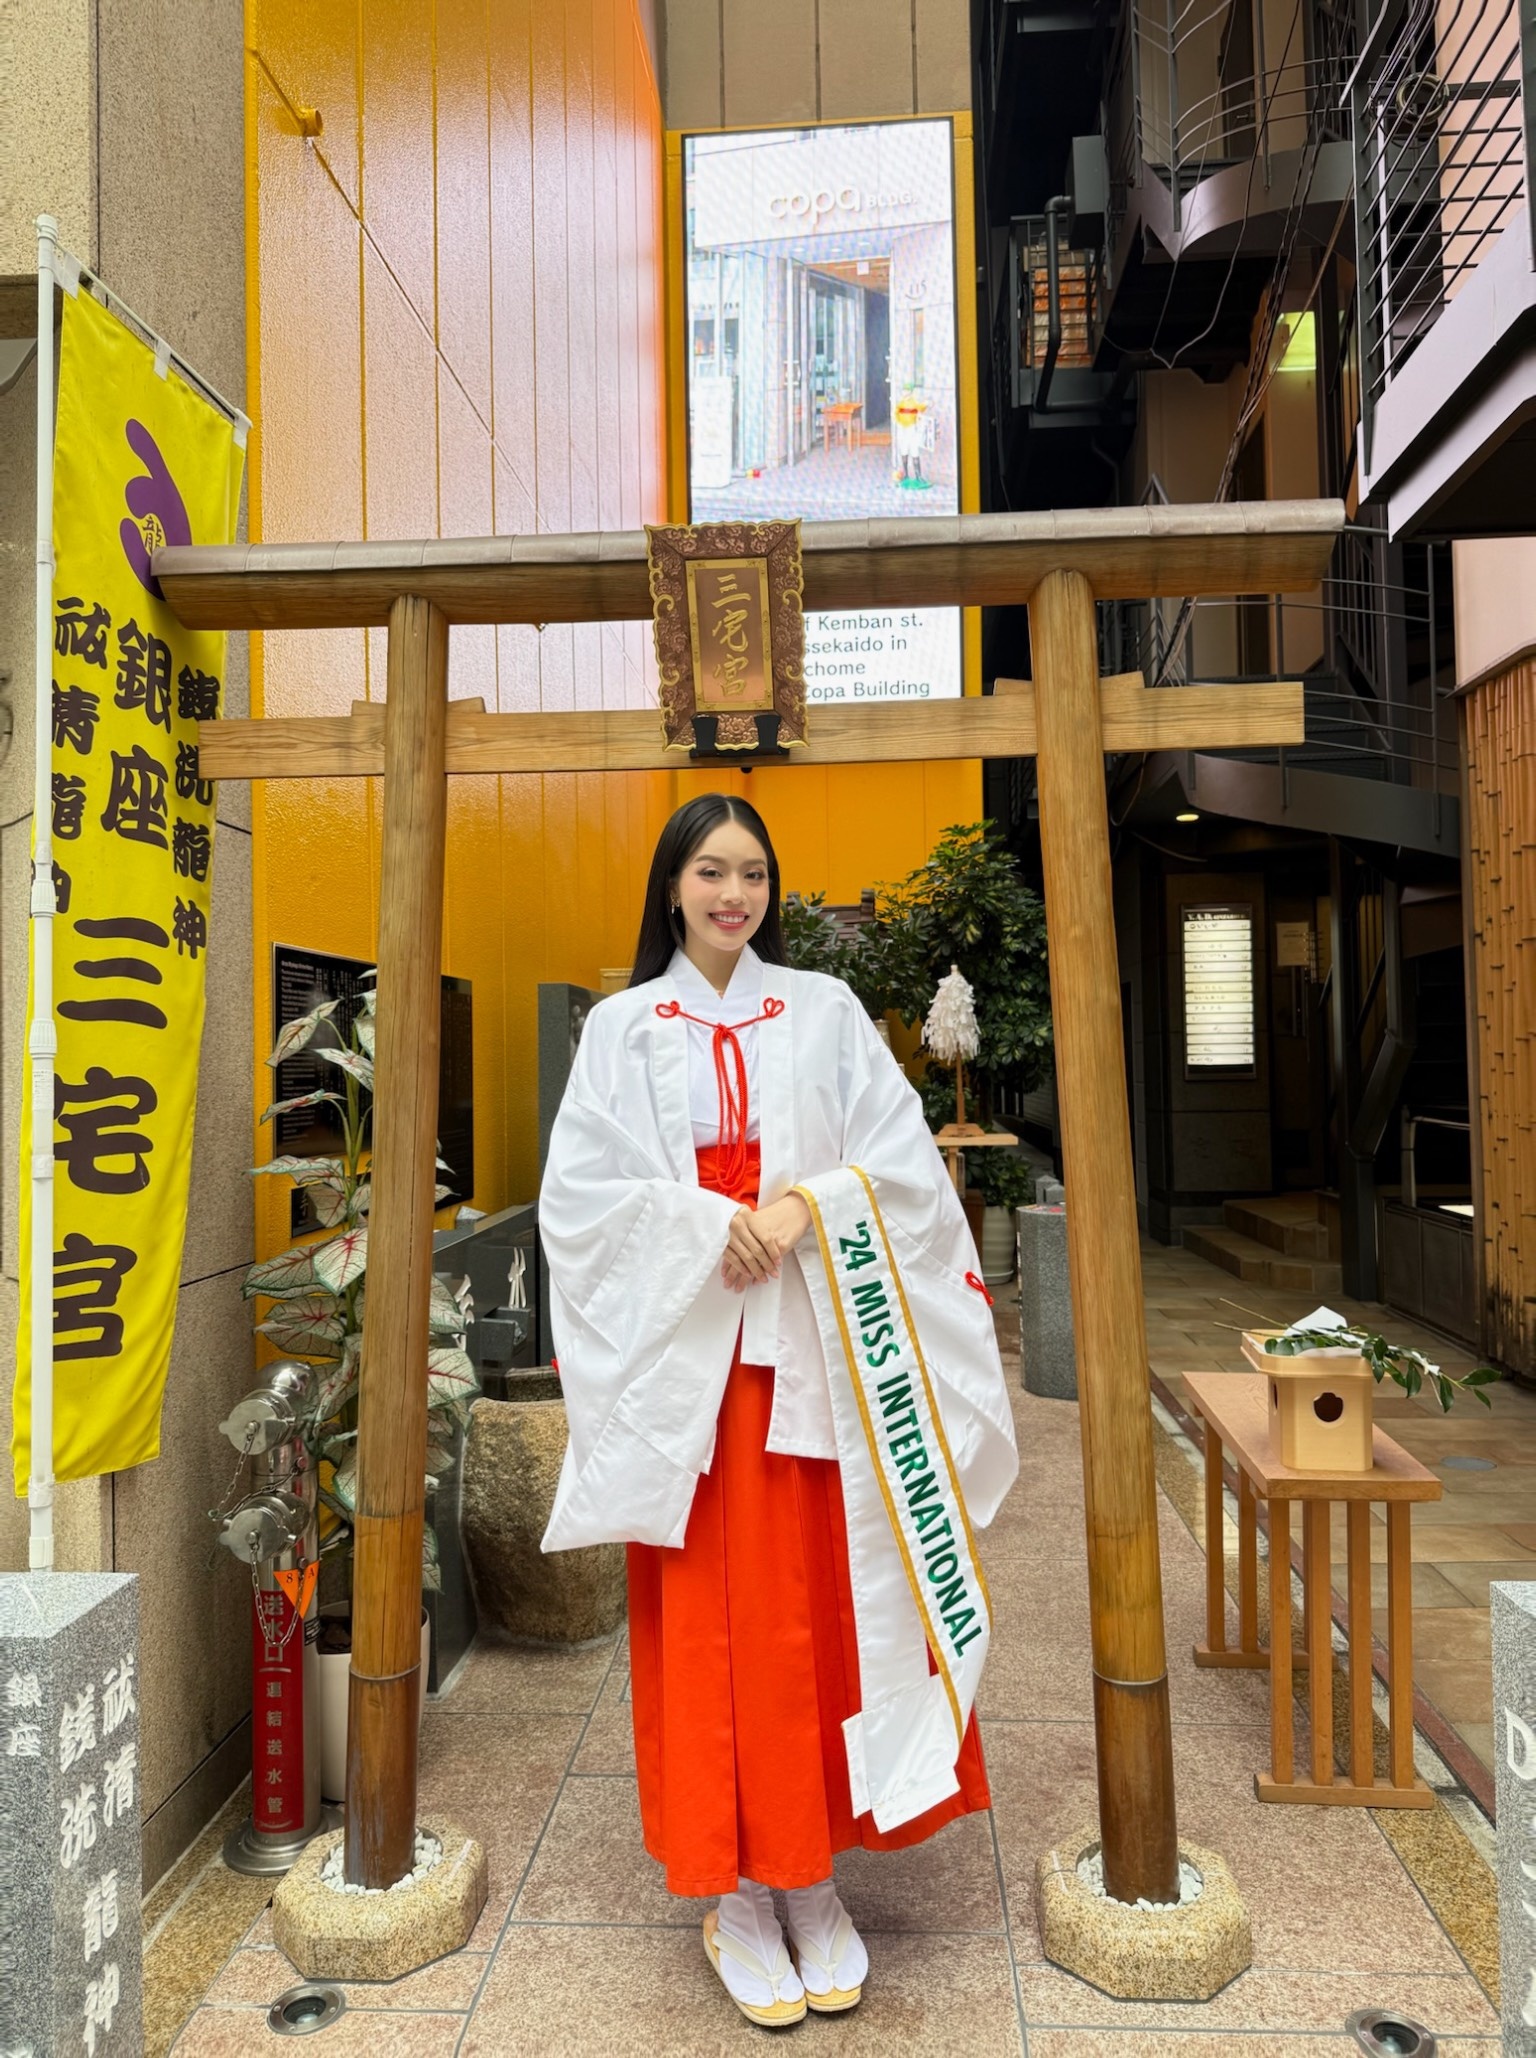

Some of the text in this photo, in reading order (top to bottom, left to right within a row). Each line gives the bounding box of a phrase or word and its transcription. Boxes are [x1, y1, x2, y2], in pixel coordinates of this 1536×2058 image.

[766, 187, 862, 235] copa
[711, 573, 752, 698] 三宅宮
[819, 614, 892, 631] Kemban
[901, 612, 923, 628] st.
[891, 635, 907, 650] in
[854, 680, 930, 697] Building
[839, 1220, 982, 1658] '24 MISS INTERNATIONAL
[263, 1594, 284, 1663] 送水口
[266, 1682, 283, 1814] 連結送水管
